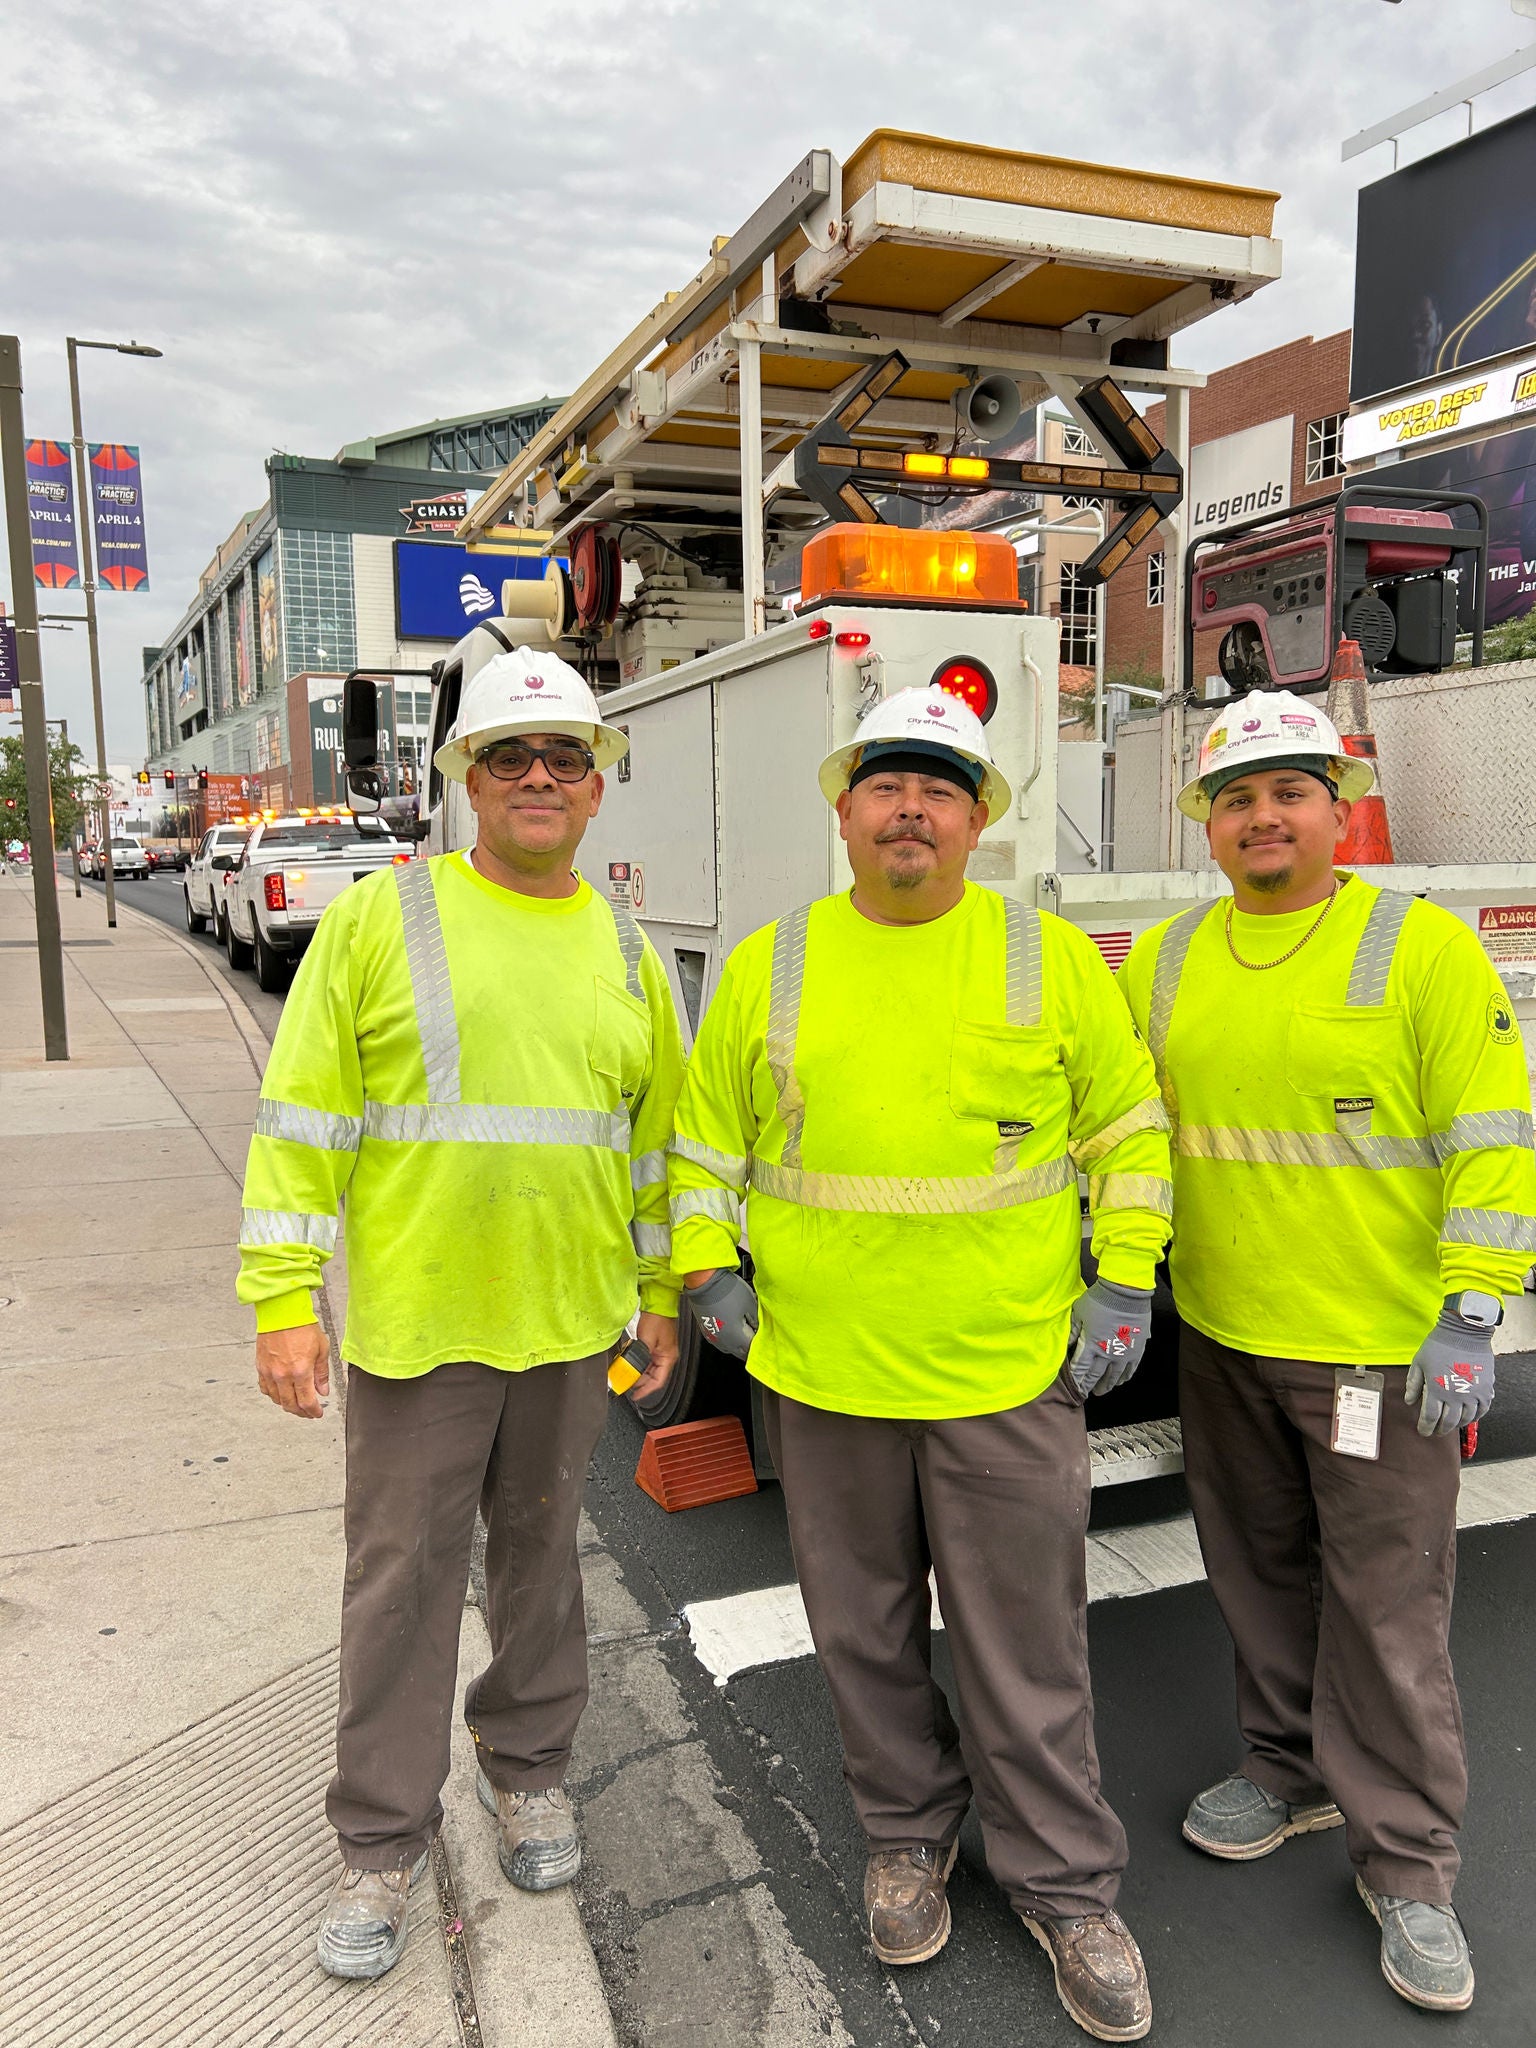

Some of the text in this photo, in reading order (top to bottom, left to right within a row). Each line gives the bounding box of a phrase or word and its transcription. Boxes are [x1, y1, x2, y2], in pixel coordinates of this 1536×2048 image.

[690, 350, 704, 374] LIFT
[1379, 382, 1488, 432] VOTED BEST
[1397, 407, 1461, 442] AGAIN!
[29, 486, 66, 496] PRACTICE
[100, 490, 135, 499] PRACTICE
[1194, 481, 1284, 526] Legends
[29, 510, 72, 523] APRIL 4
[417, 505, 466, 517] CHASE
[97, 514, 141, 525] APRIL 4
[1488, 564, 1519, 581] THE
[932, 720, 959, 733] Phoenix
[314, 727, 345, 751] RUL
[1227, 741, 1241, 749] City
[1250, 732, 1280, 741] Phoenix
[136, 785, 153, 797] that
[1500, 911, 1536, 924] DANG
